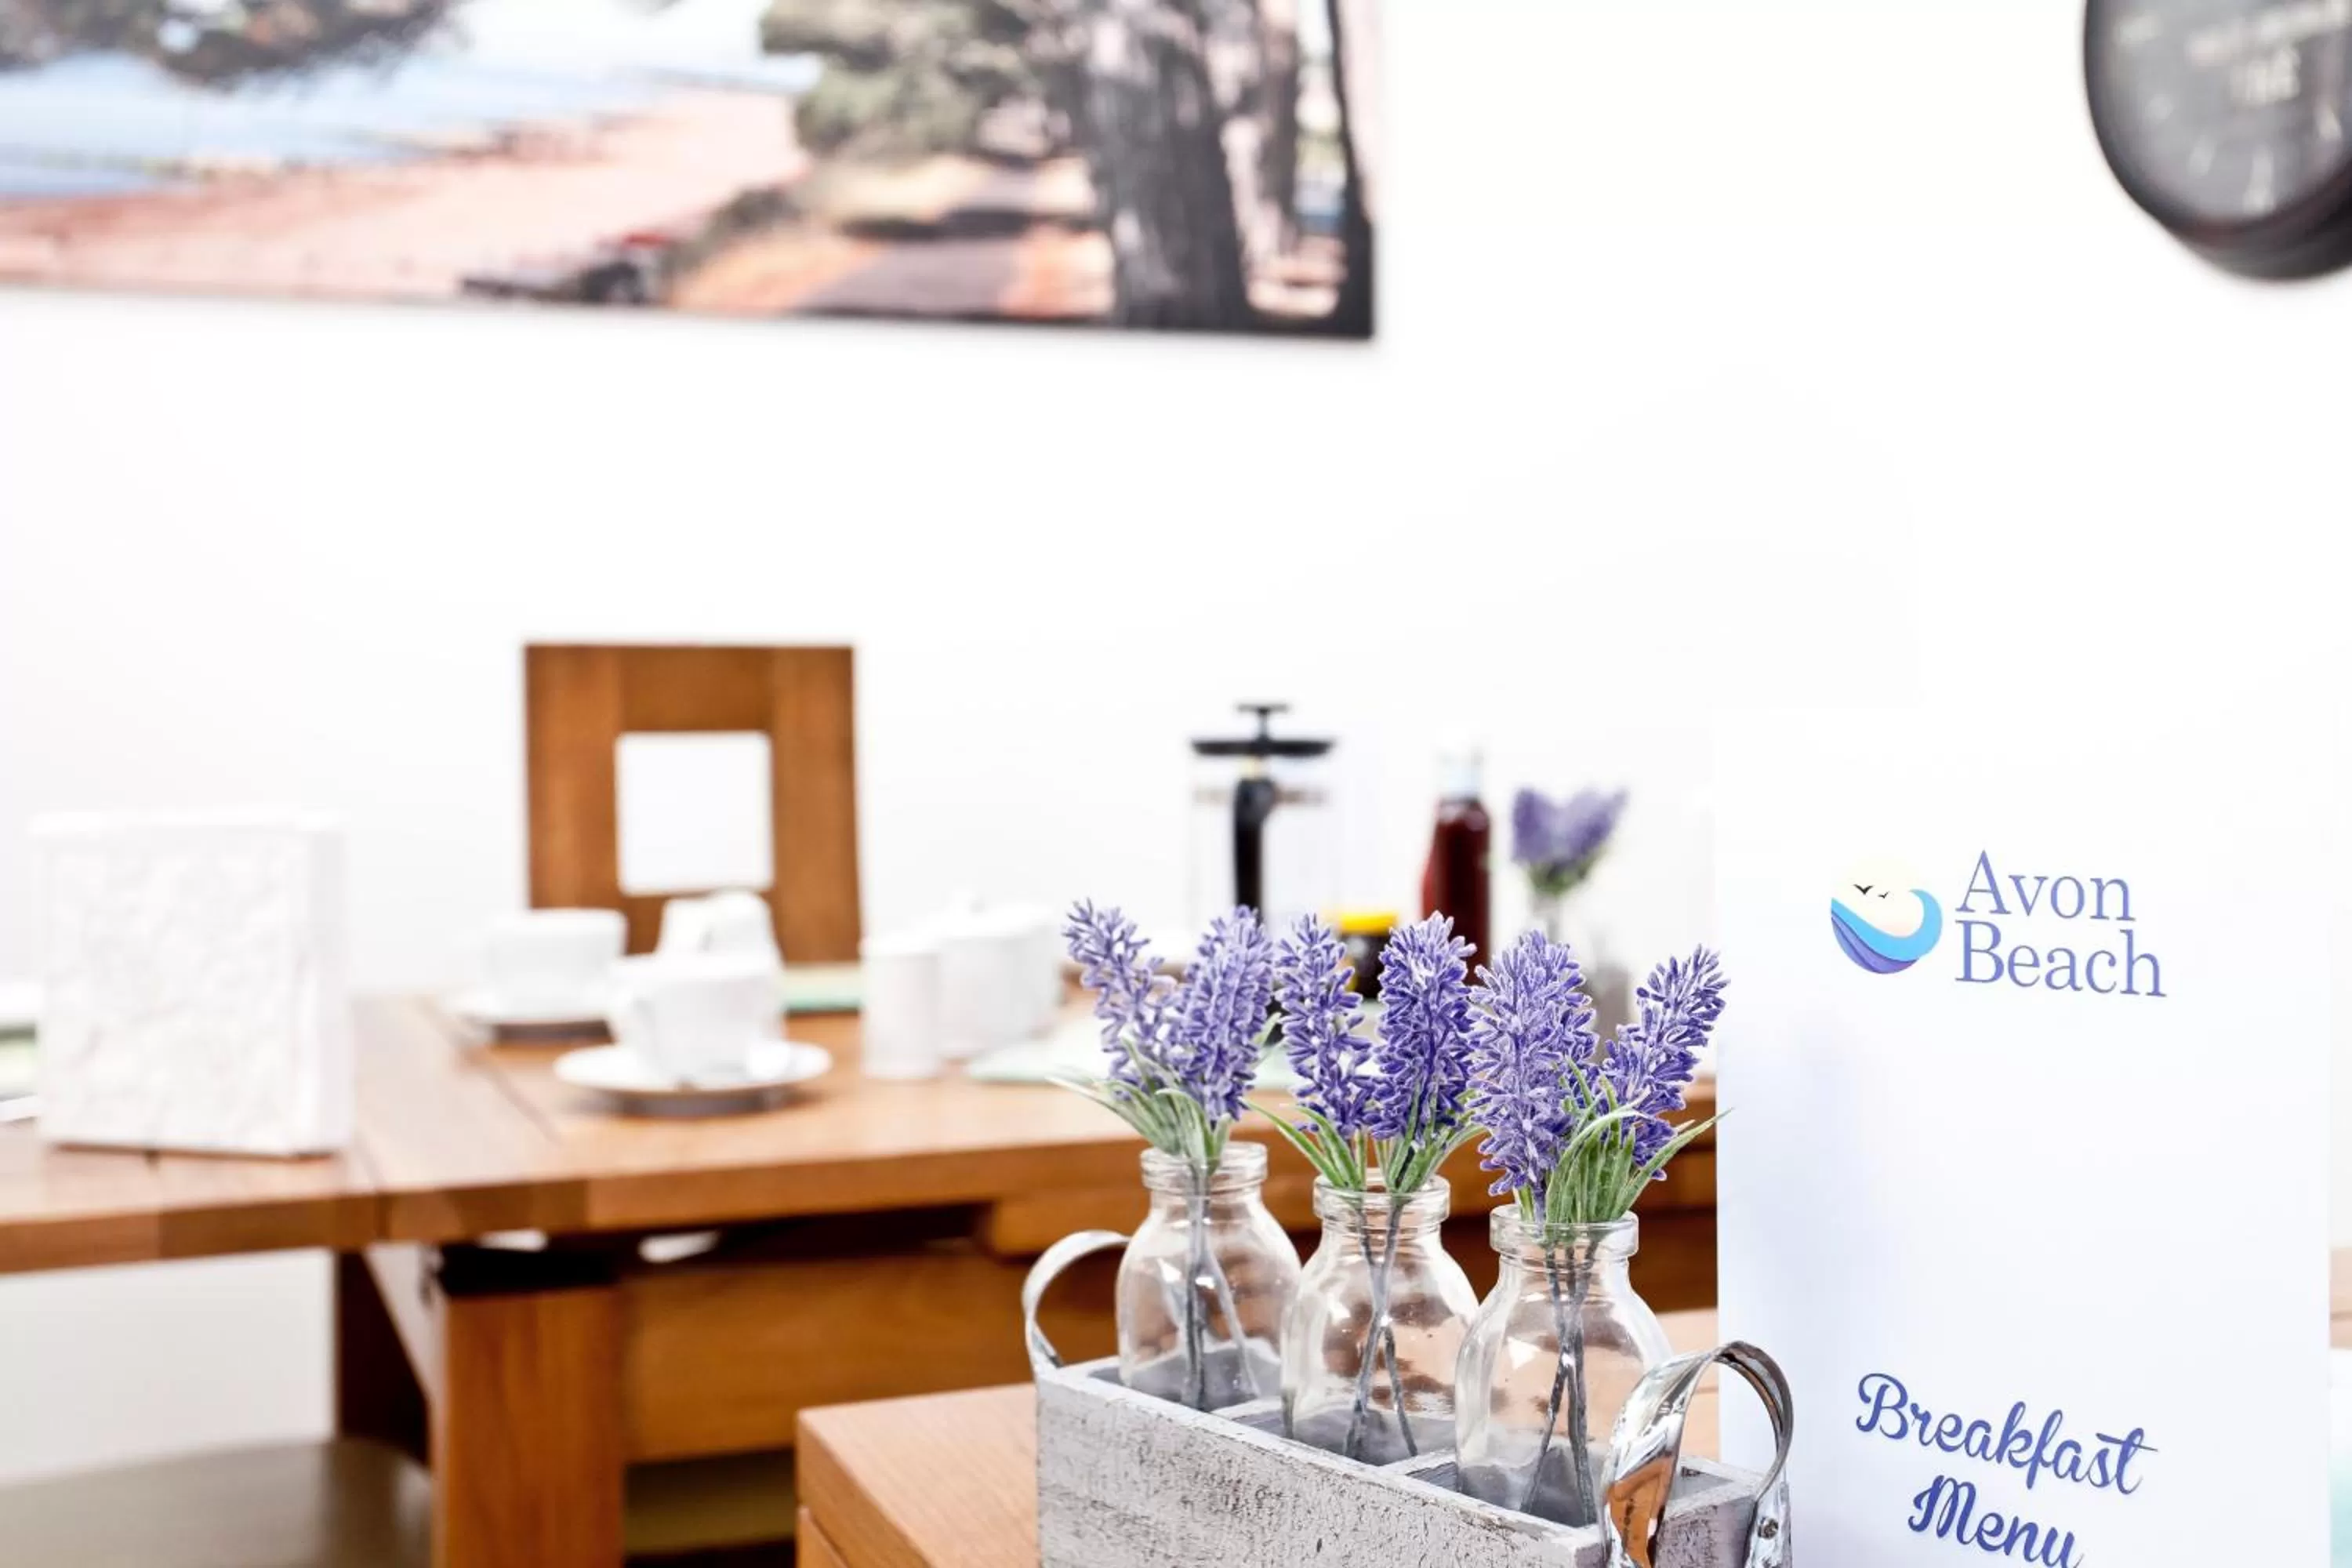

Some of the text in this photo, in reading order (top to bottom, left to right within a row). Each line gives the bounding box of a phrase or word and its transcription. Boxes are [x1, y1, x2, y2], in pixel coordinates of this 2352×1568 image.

[1955, 850, 2136, 922] Avon
[1955, 920, 2167, 997] Beach
[1856, 1373, 2158, 1494] Breakfast
[1907, 1475, 2084, 1568] Menu
